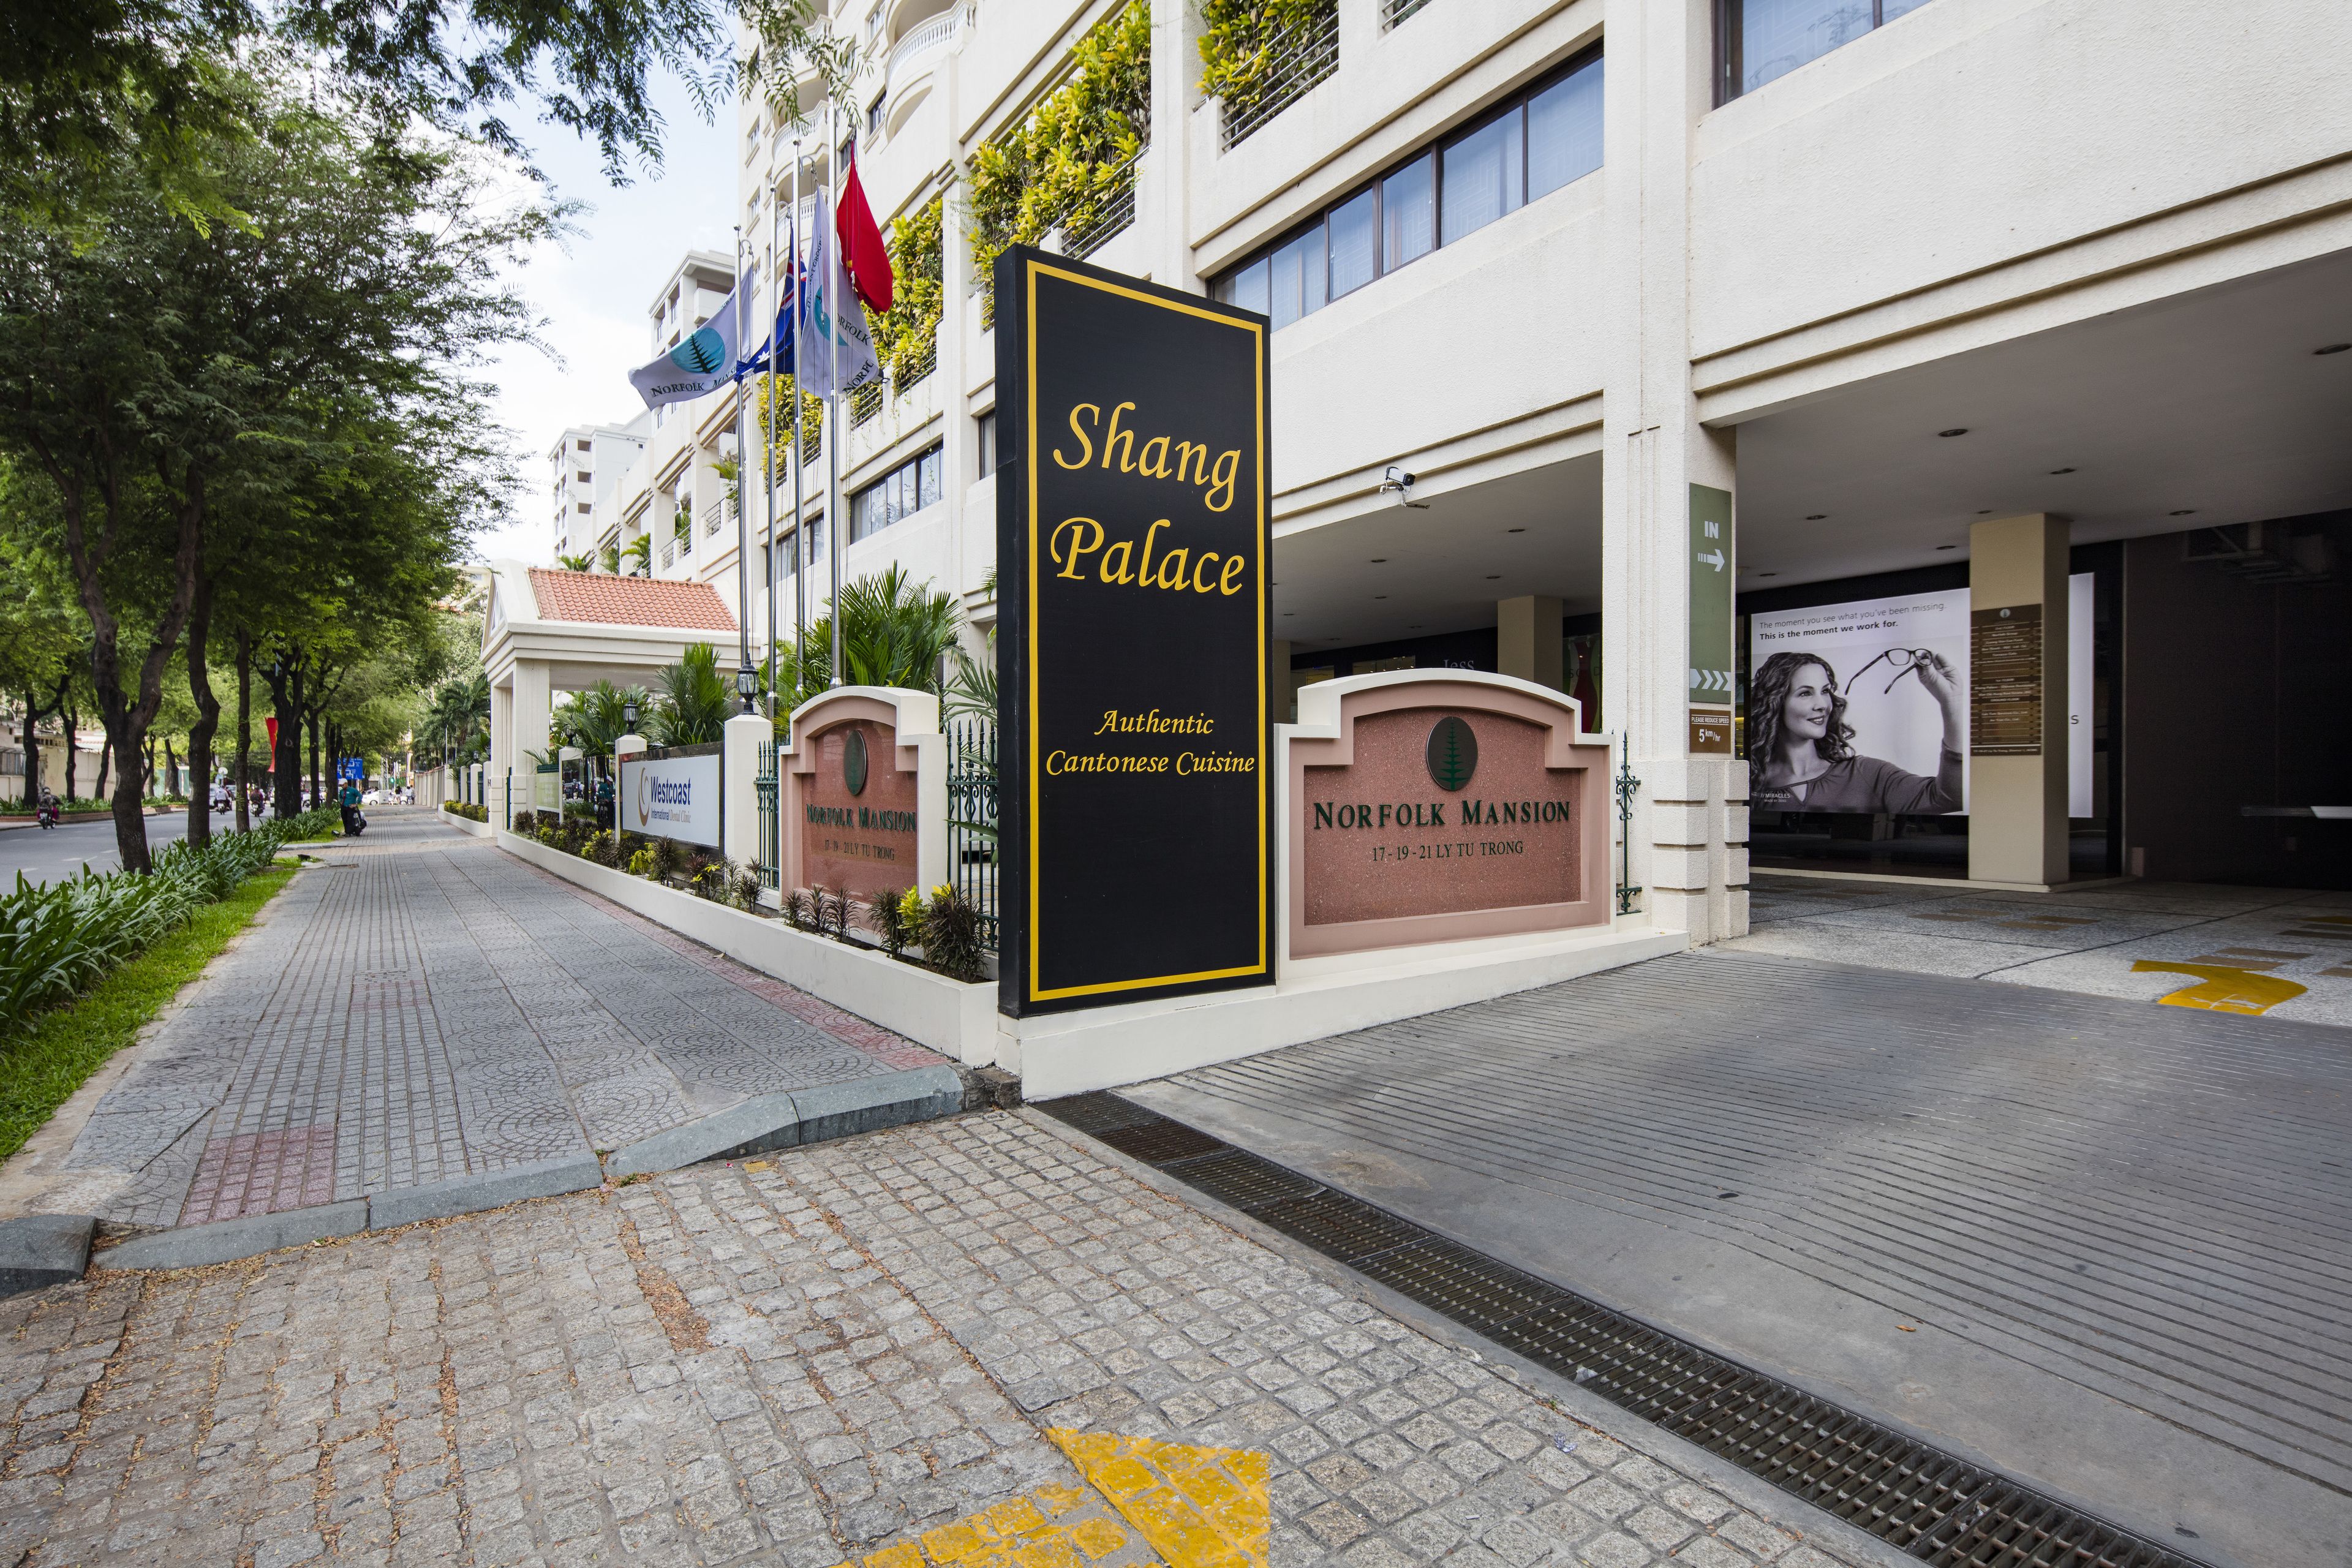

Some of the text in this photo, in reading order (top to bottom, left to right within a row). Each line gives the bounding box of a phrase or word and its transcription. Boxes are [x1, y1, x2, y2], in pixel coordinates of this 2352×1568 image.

[650, 382, 705, 397] NORFOLK
[1053, 401, 1242, 512] Shang
[1704, 521, 1719, 539] IN
[1050, 517, 1245, 596] Palace
[1775, 619, 1805, 627] moment
[1807, 617, 1821, 626] you
[1860, 609, 1887, 620] you've
[1888, 607, 1910, 616] been
[1912, 603, 1948, 612] missing.
[1803, 627, 1838, 636] moment
[1856, 622, 1880, 630] work
[1093, 709, 1214, 736] Authentic
[1699, 728, 1705, 742] 5
[1046, 750, 1255, 776] Cantonese Cuisine
[650, 776, 691, 805] Westcoast
[651, 808, 670, 821] International
[806, 804, 916, 832] NORFOLK MANSION
[1314, 800, 1570, 829] NORFOLK MANSION
[861, 843, 870, 858] TU
[872, 845, 895, 861] TRONG
[1436, 844, 1453, 858] LY
[1457, 843, 1474, 857] TU
[1480, 840, 1524, 856] TRONG
